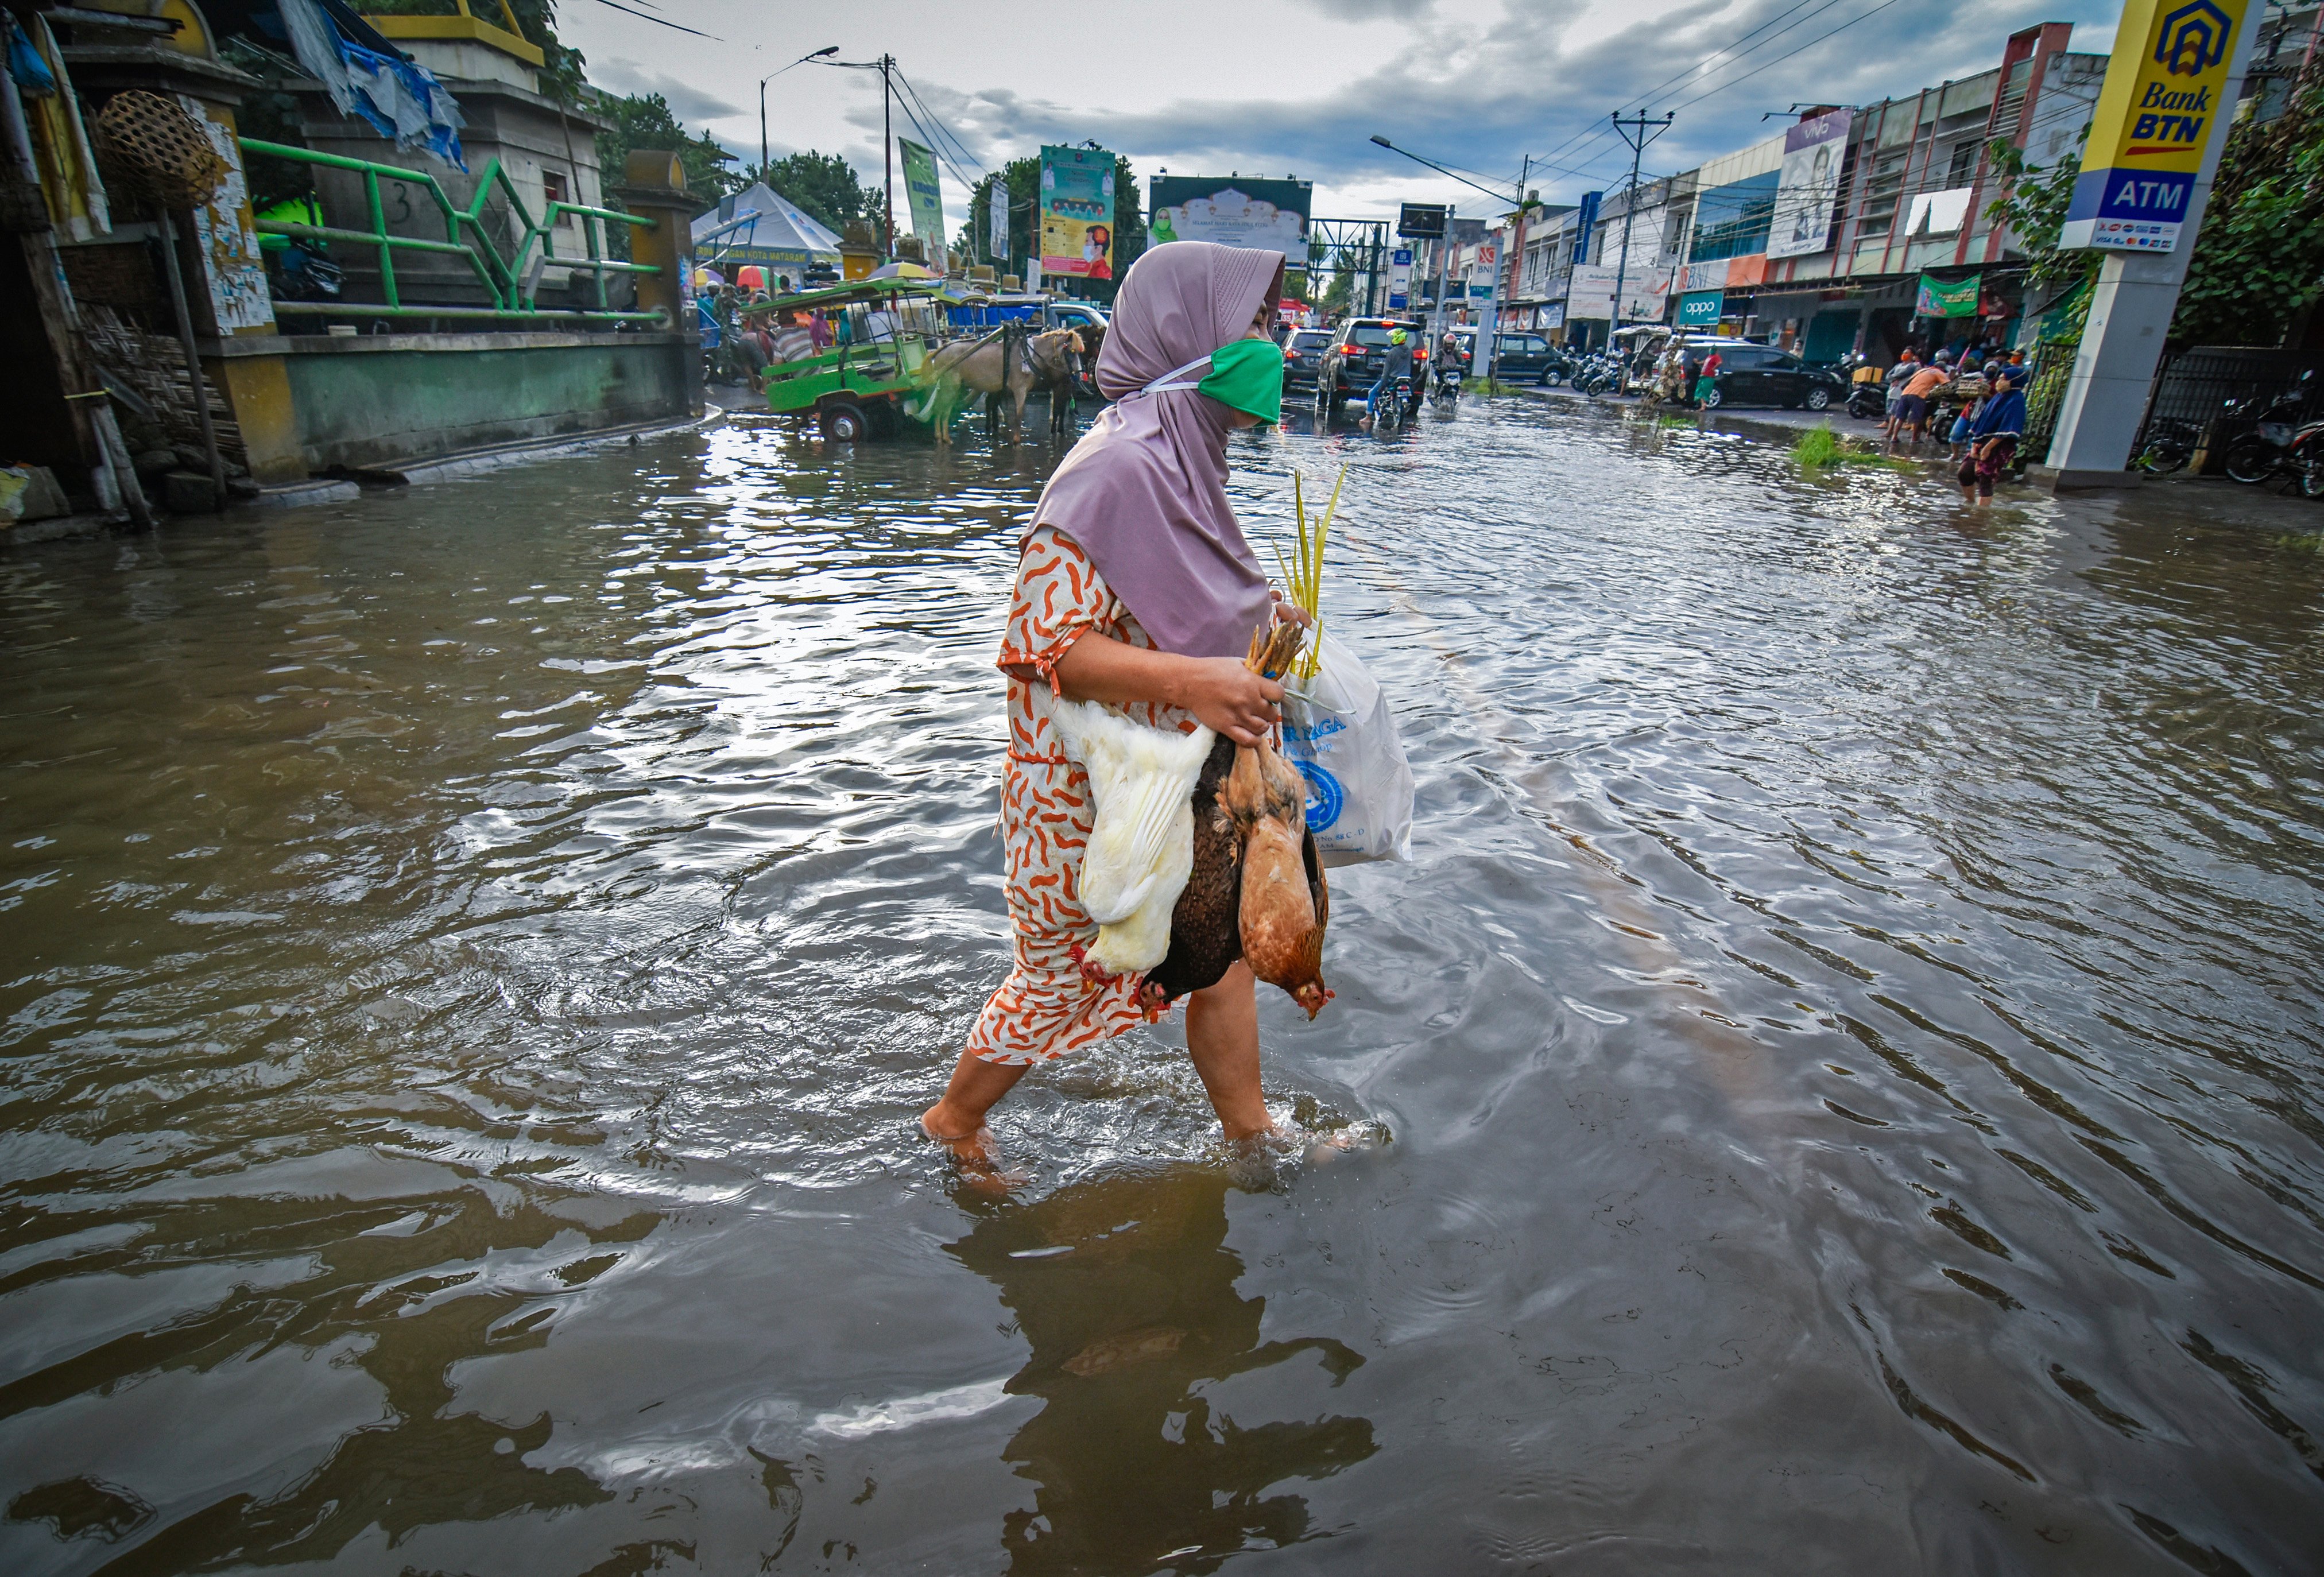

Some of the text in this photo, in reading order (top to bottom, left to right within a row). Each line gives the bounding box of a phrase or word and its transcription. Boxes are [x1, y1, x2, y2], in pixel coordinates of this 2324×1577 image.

[2138, 82, 2212, 112] Bank
[1804, 122, 1830, 139] vivo
[2130, 113, 2205, 143] BTN
[393, 182, 410, 224] 3
[2112, 180, 2184, 210] ATM
[747, 251, 768, 261] KOTA
[769, 253, 806, 262] MATARAM
[1478, 265, 1493, 273] BNI
[1686, 264, 1710, 289] BNI
[1686, 301, 1715, 316] oppo
